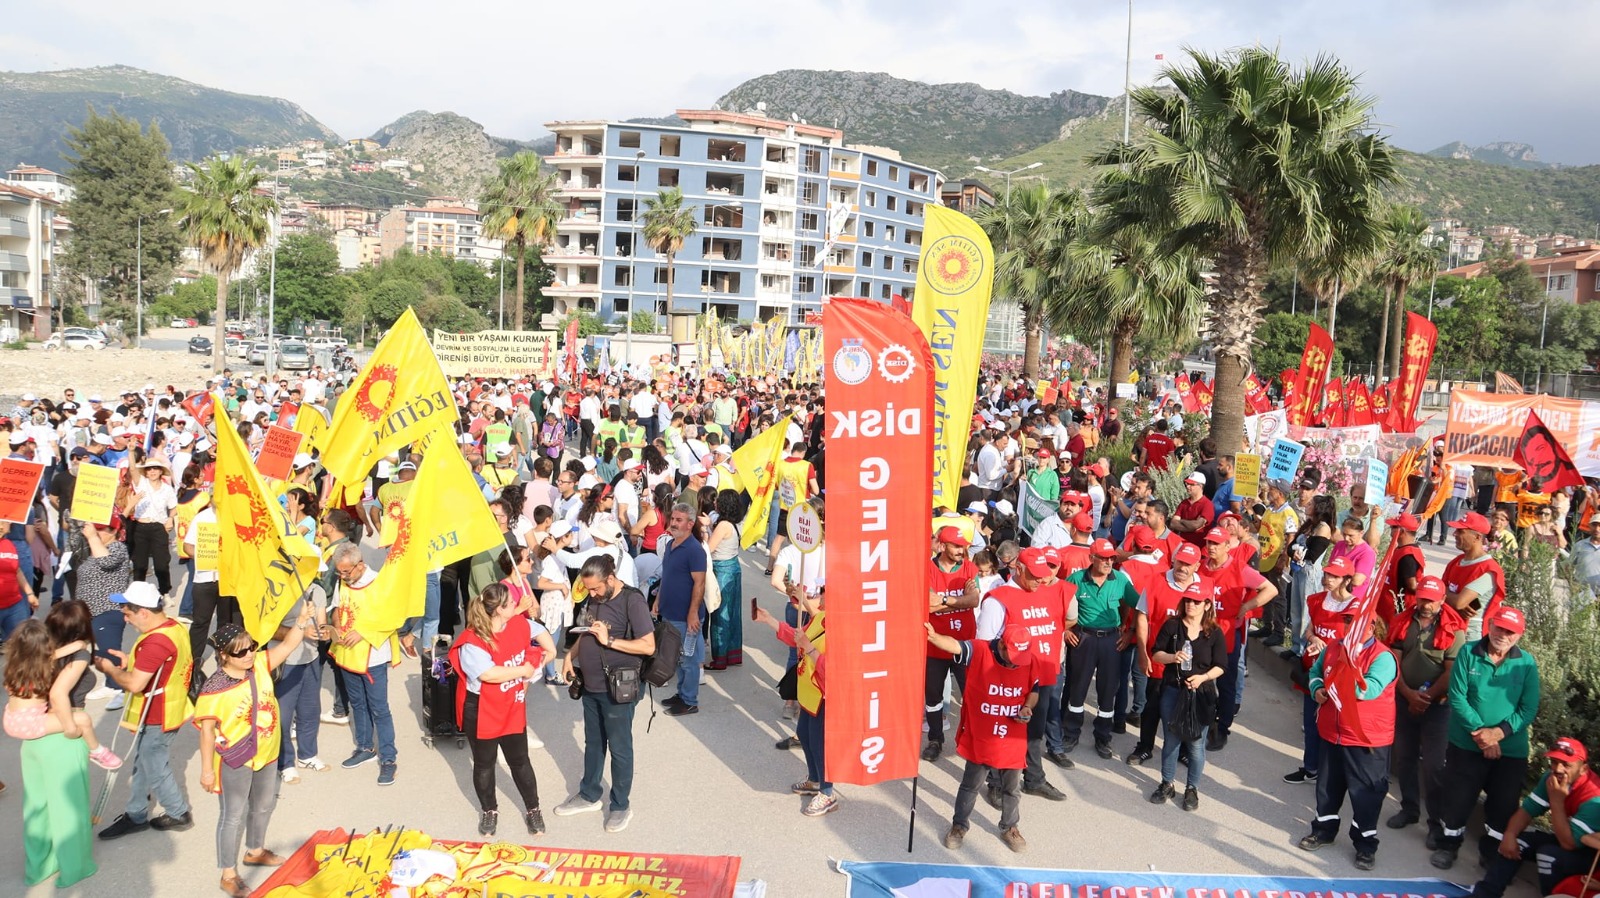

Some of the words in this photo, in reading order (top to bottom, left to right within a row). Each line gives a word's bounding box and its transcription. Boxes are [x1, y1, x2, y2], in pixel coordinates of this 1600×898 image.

[2, 466, 37, 478] DEPREM
[1022, 605, 1049, 619] DİSK
[950, 618, 962, 632] İŞ
[1038, 640, 1051, 655] İŞ
[988, 683, 1023, 698] DİSK
[992, 721, 1008, 739] İŞ
